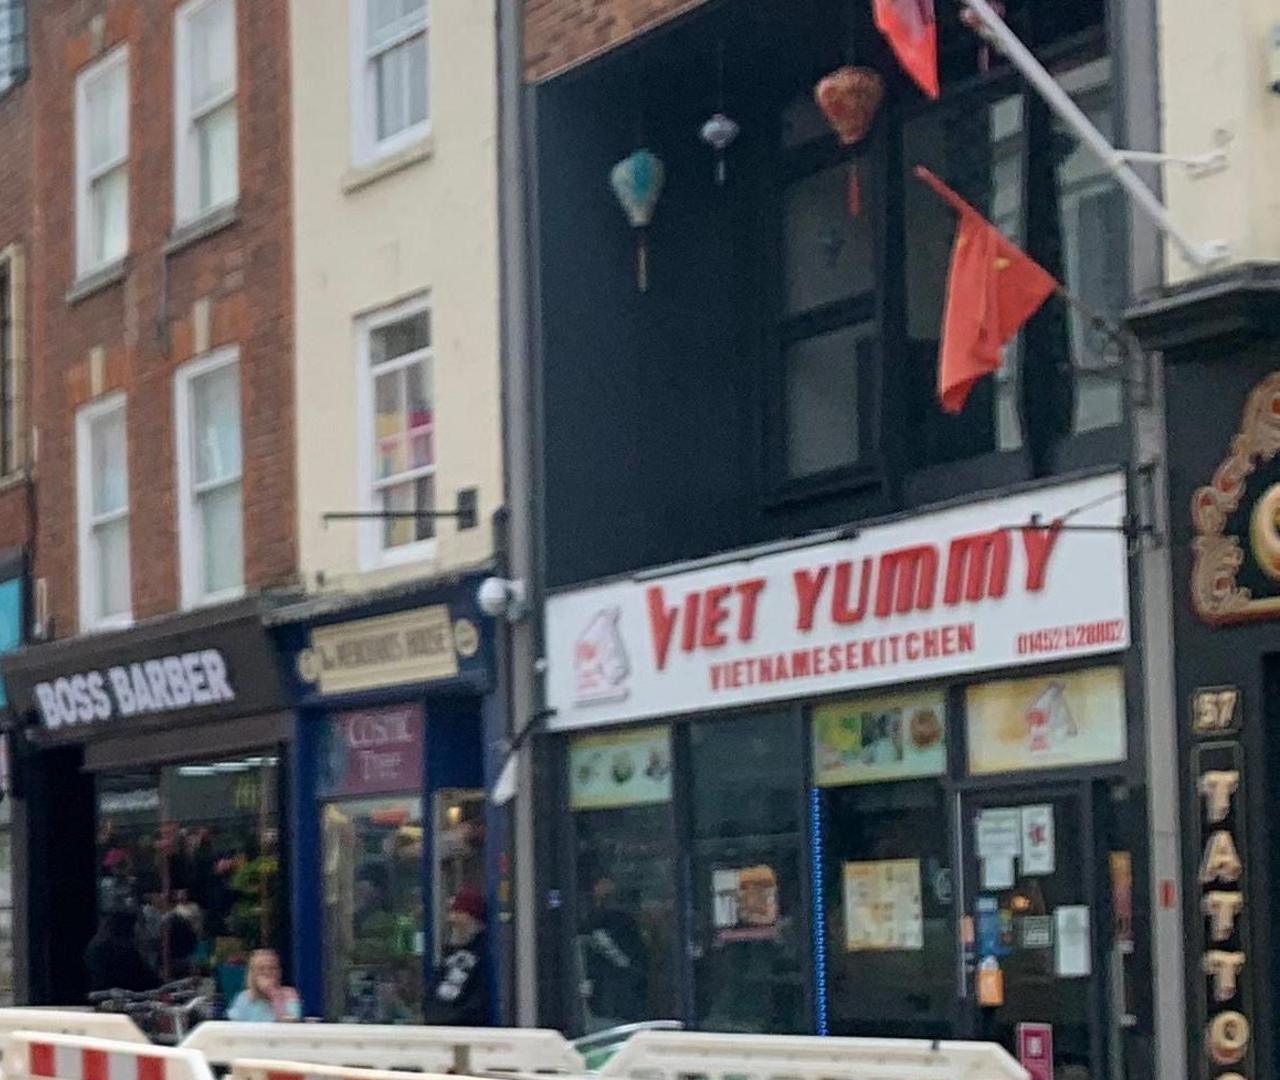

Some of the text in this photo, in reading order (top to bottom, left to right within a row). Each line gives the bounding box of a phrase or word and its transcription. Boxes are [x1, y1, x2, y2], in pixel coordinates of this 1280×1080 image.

[645, 516, 1064, 672] VIET YUMMY
[35, 669, 112, 730] BOSS
[107, 648, 236, 717] BARBER
[1195, 689, 1239, 730] 57
